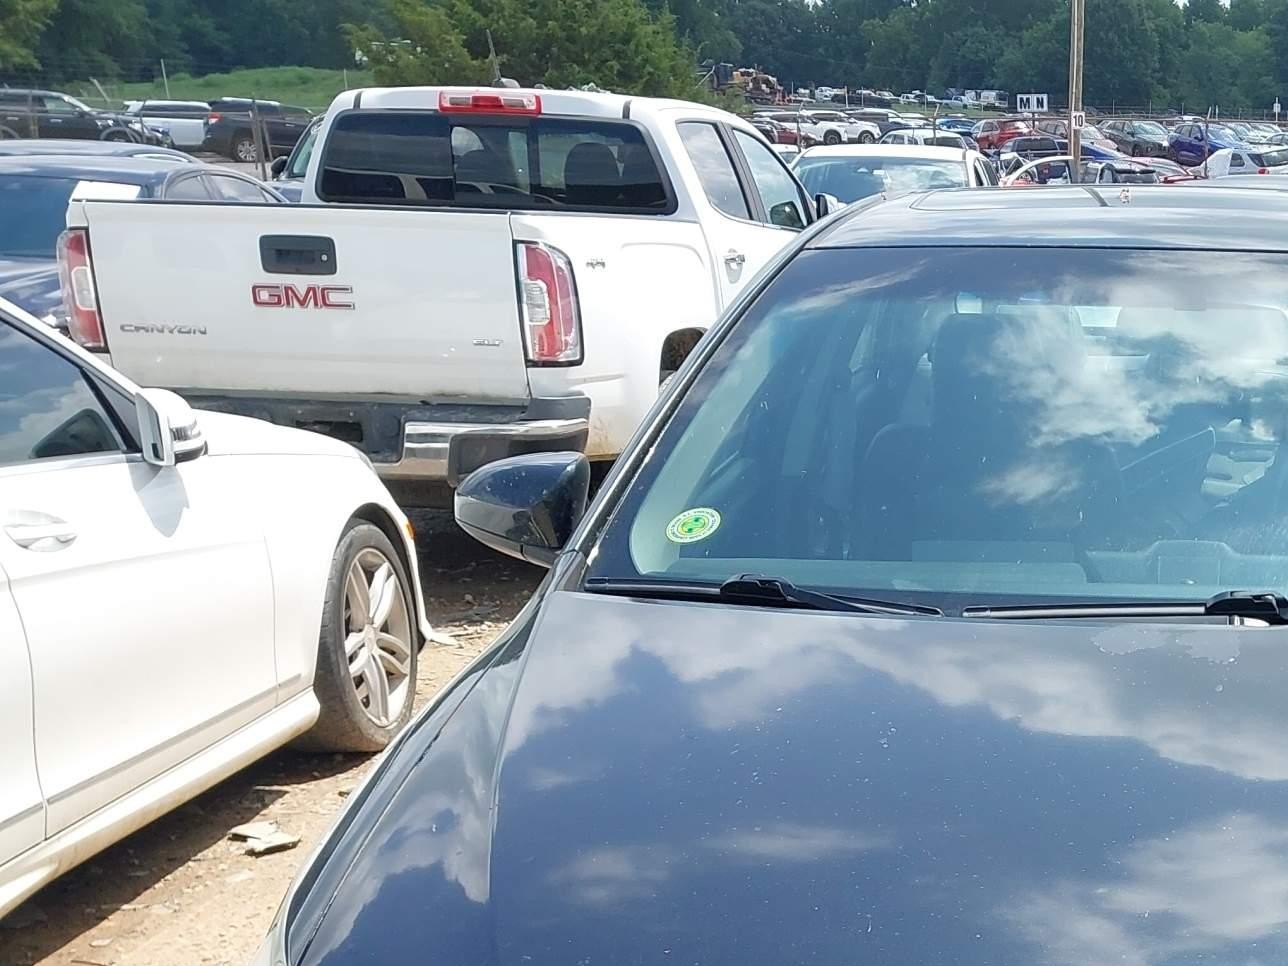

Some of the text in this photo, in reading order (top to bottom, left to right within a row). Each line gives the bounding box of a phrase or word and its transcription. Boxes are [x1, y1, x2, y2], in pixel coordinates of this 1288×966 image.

[1019, 97, 1044, 110] M N
[1073, 114, 1084, 127] 10
[252, 283, 355, 310] GMC
[119, 323, 208, 335] CANYON
